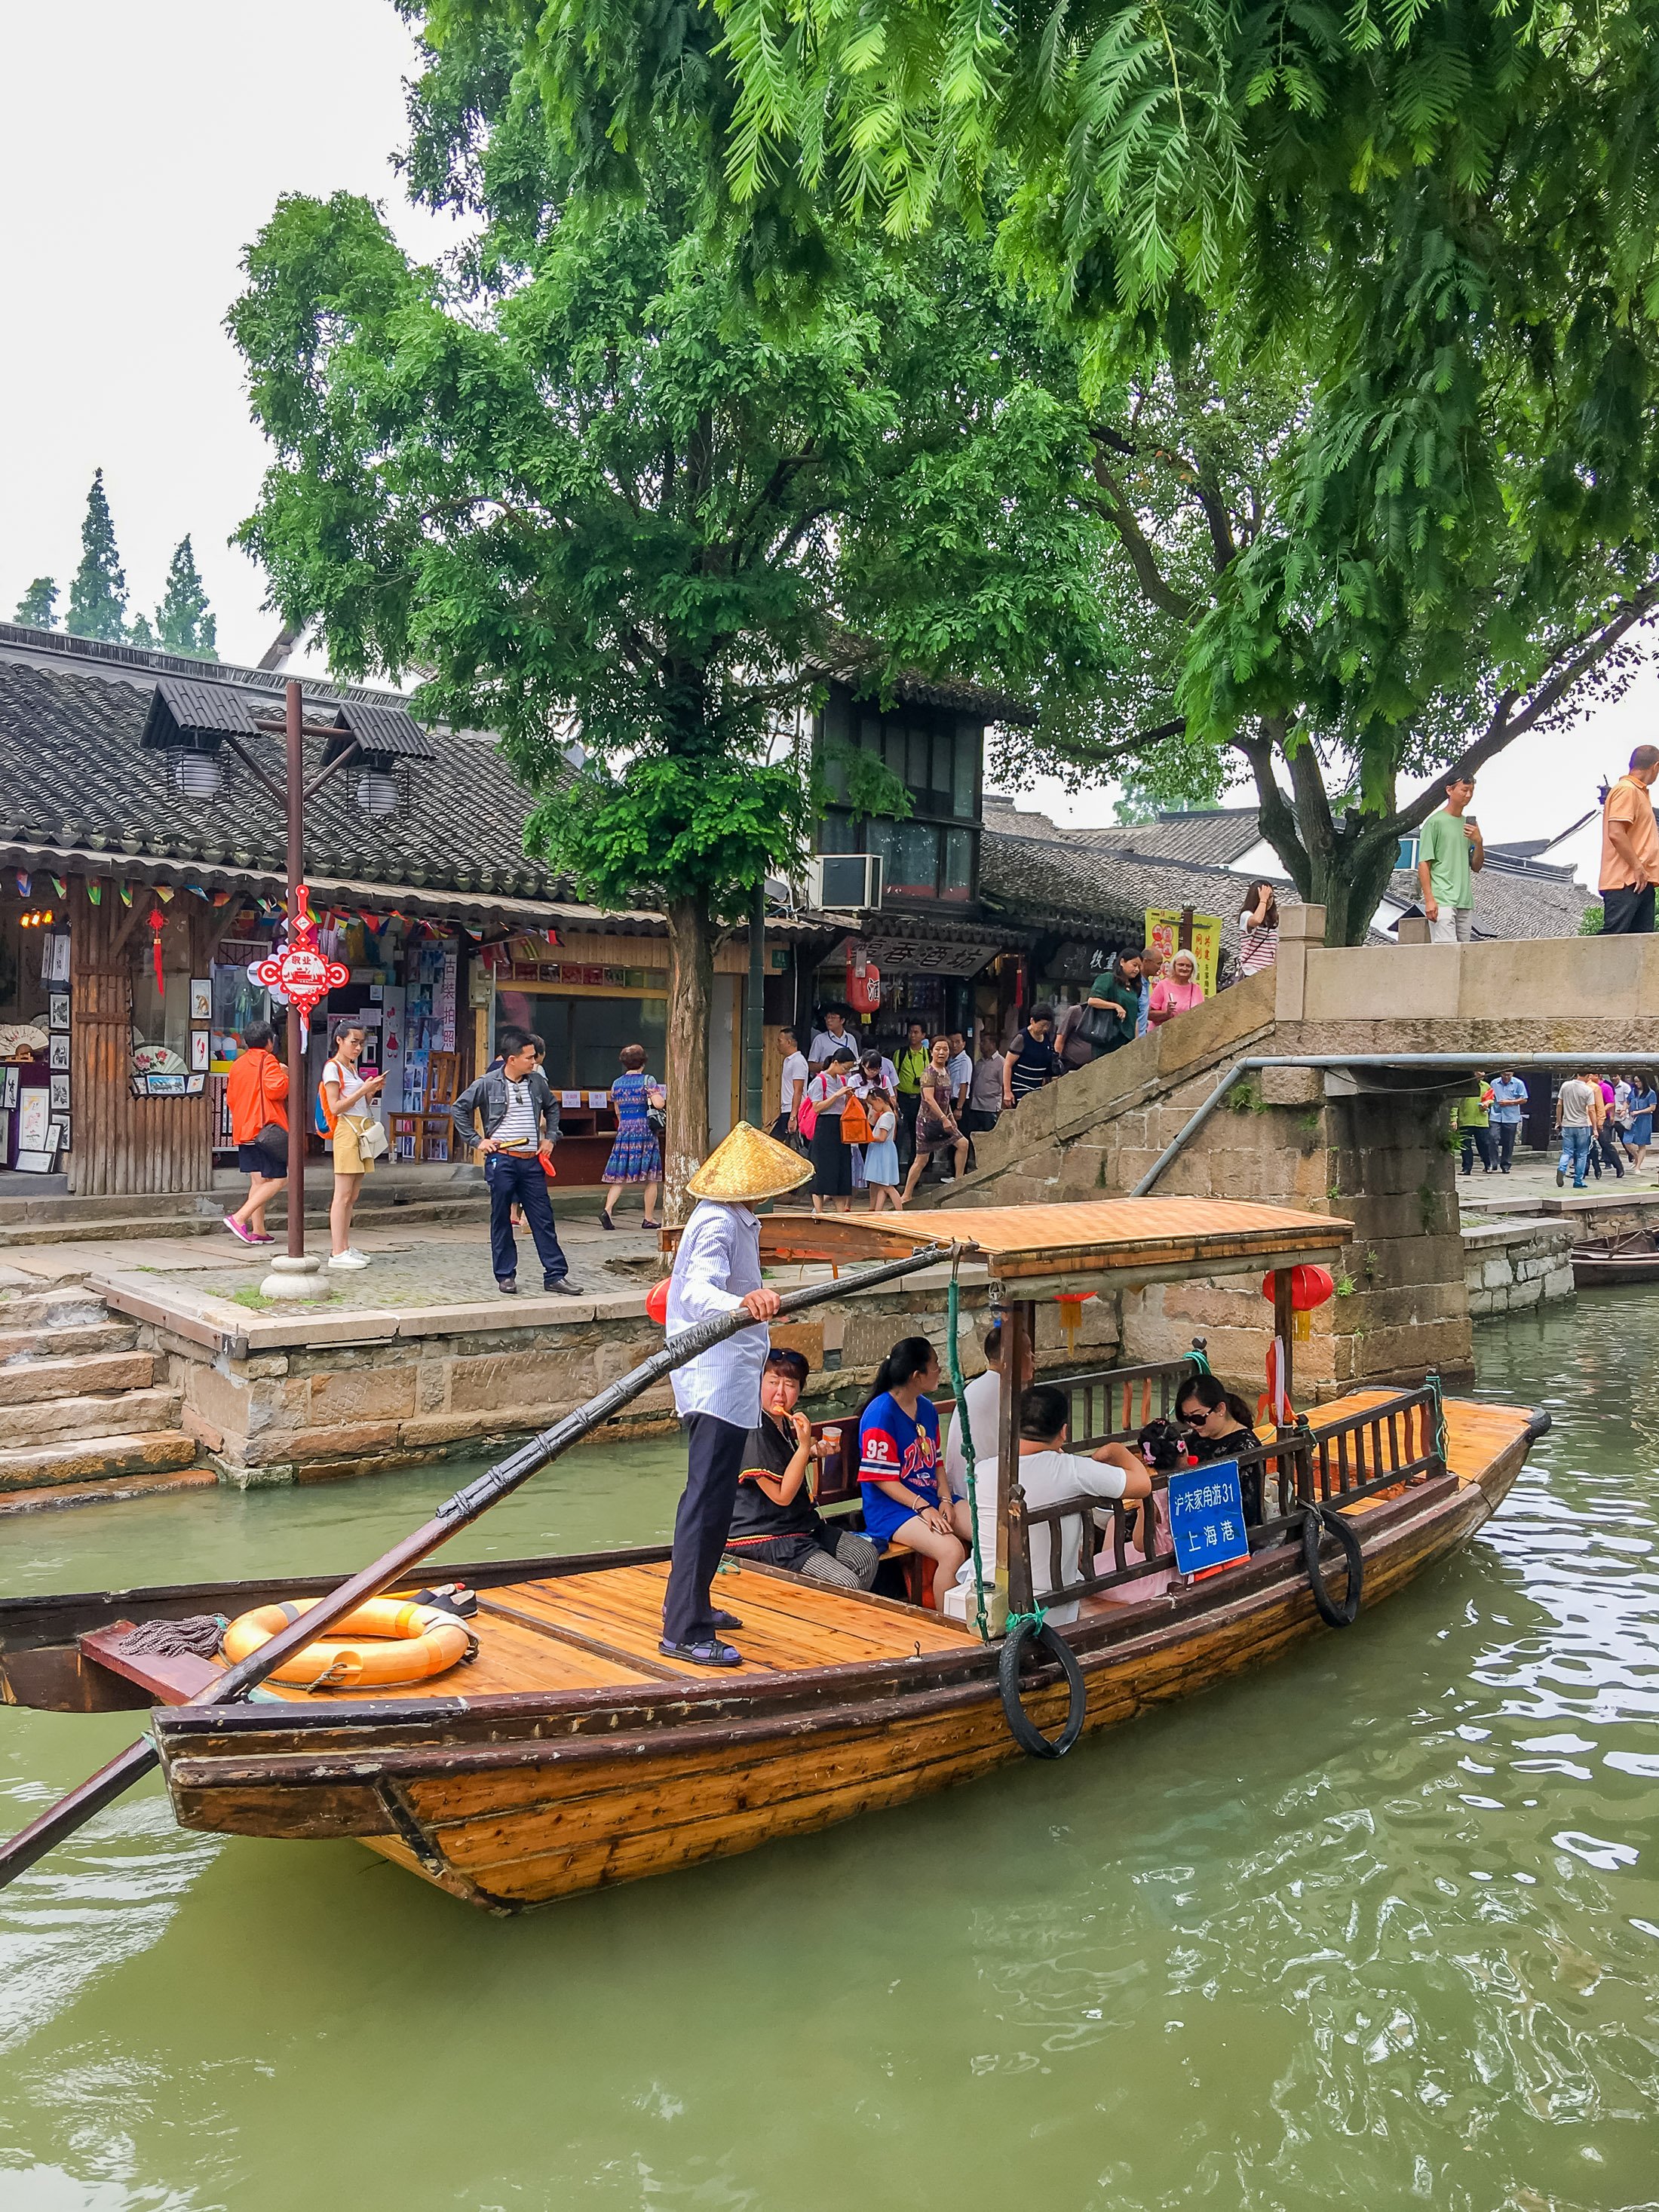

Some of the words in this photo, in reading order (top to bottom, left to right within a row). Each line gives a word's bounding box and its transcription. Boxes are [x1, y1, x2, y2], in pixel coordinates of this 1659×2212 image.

[291, 956, 311, 965] 敬业
[443, 958, 456, 1048] 古装拍照
[866, 1439, 889, 1461] 92
[1174, 1483, 1234, 1517] 沪朱家角游31
[1188, 1519, 1235, 1553] 上海港
